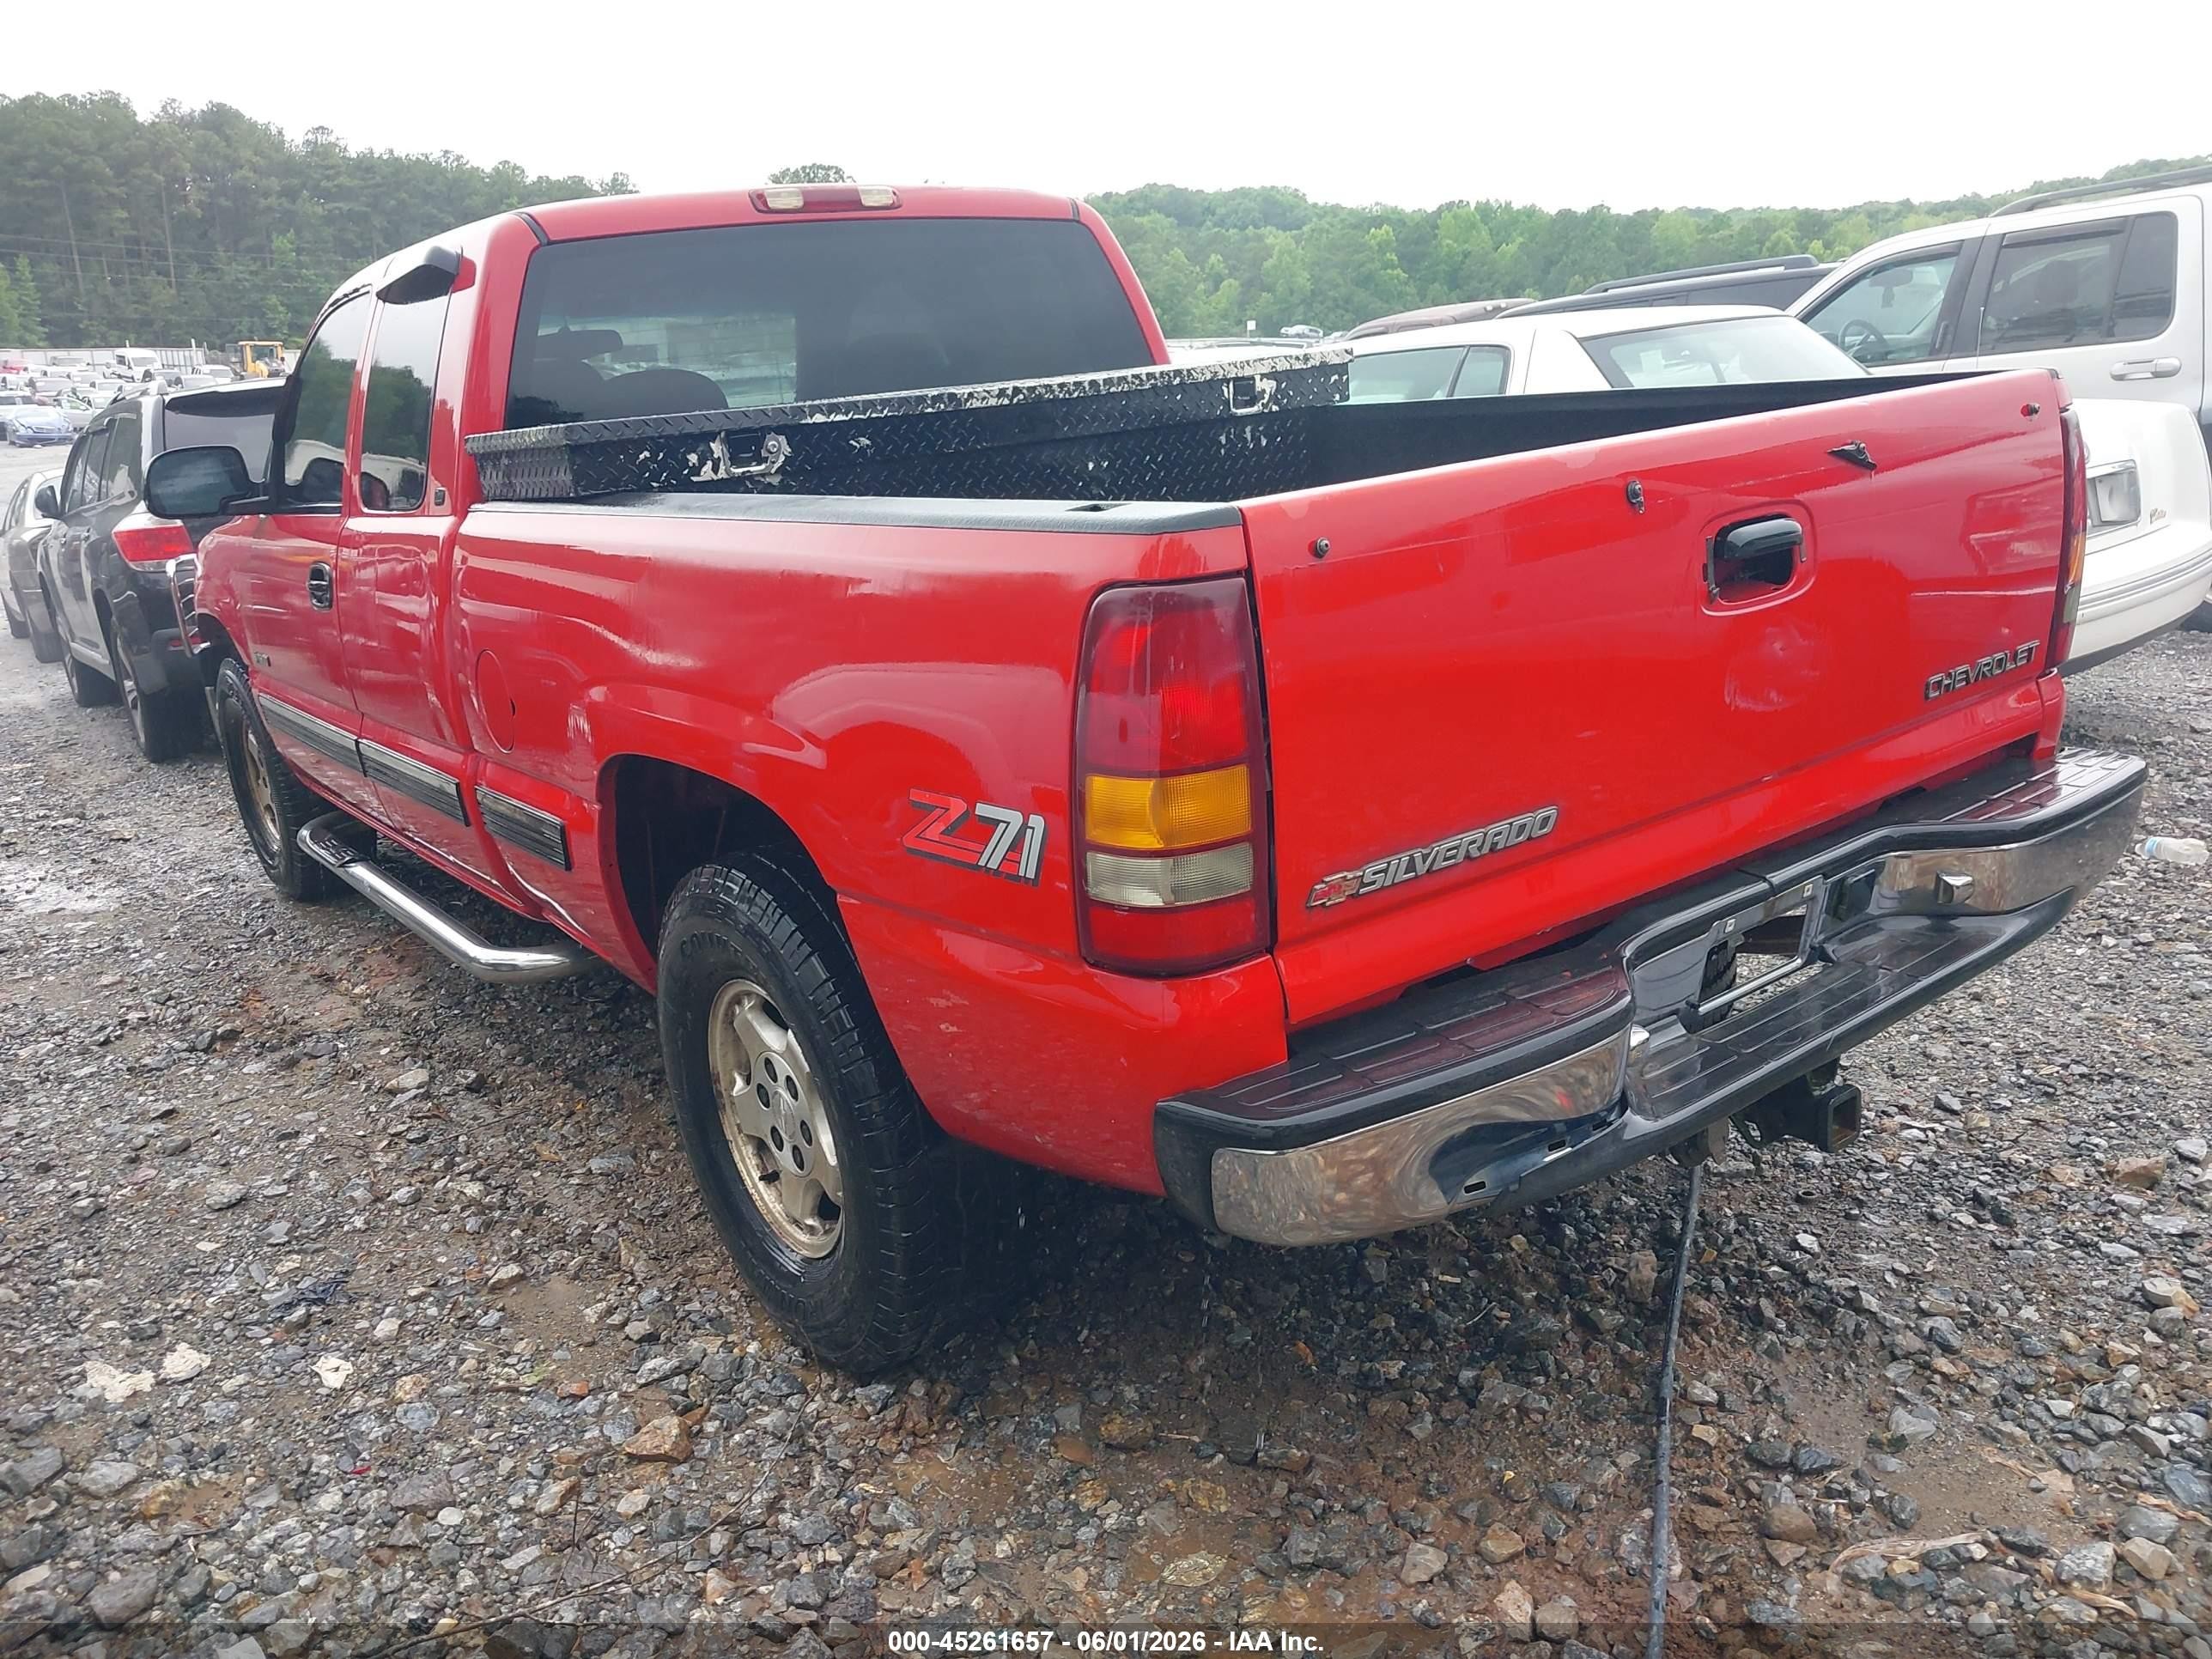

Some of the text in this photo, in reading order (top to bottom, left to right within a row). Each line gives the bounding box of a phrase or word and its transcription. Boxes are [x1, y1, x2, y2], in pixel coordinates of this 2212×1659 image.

[1925, 640, 2040, 700] CHEVROLET
[902, 787, 1047, 884] Z71
[1358, 805, 1559, 896] SILVERADO
